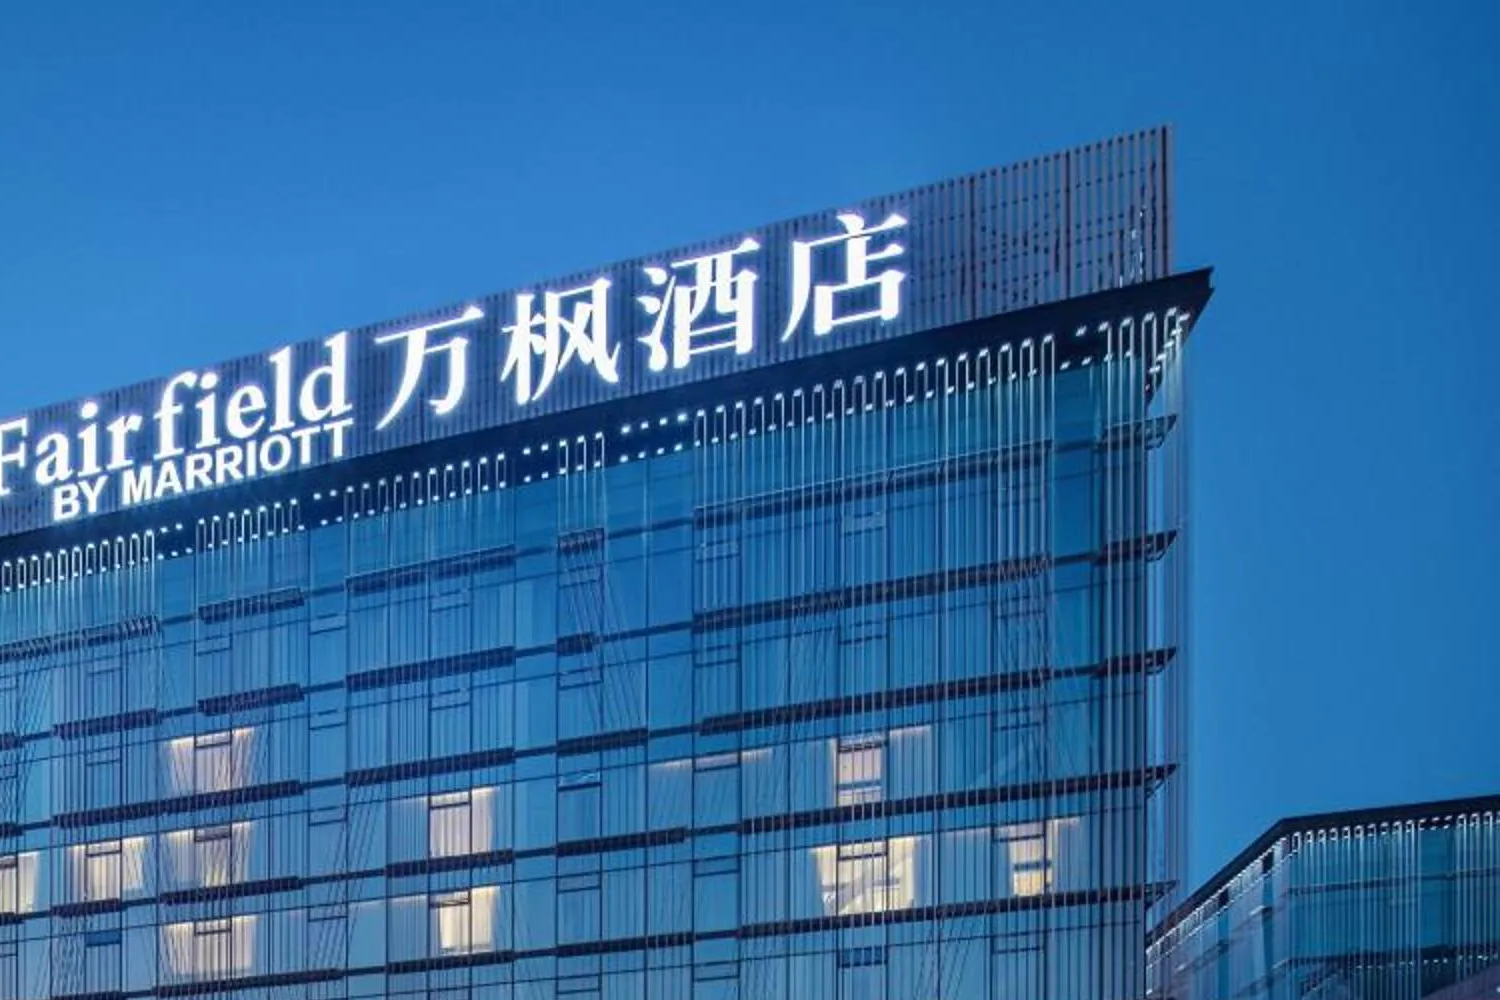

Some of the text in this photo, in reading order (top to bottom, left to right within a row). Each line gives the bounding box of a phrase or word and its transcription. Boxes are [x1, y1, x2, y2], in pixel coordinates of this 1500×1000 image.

[374, 213, 908, 431] 万枫酒店
[53, 418, 355, 523] BY MARRIOTT
